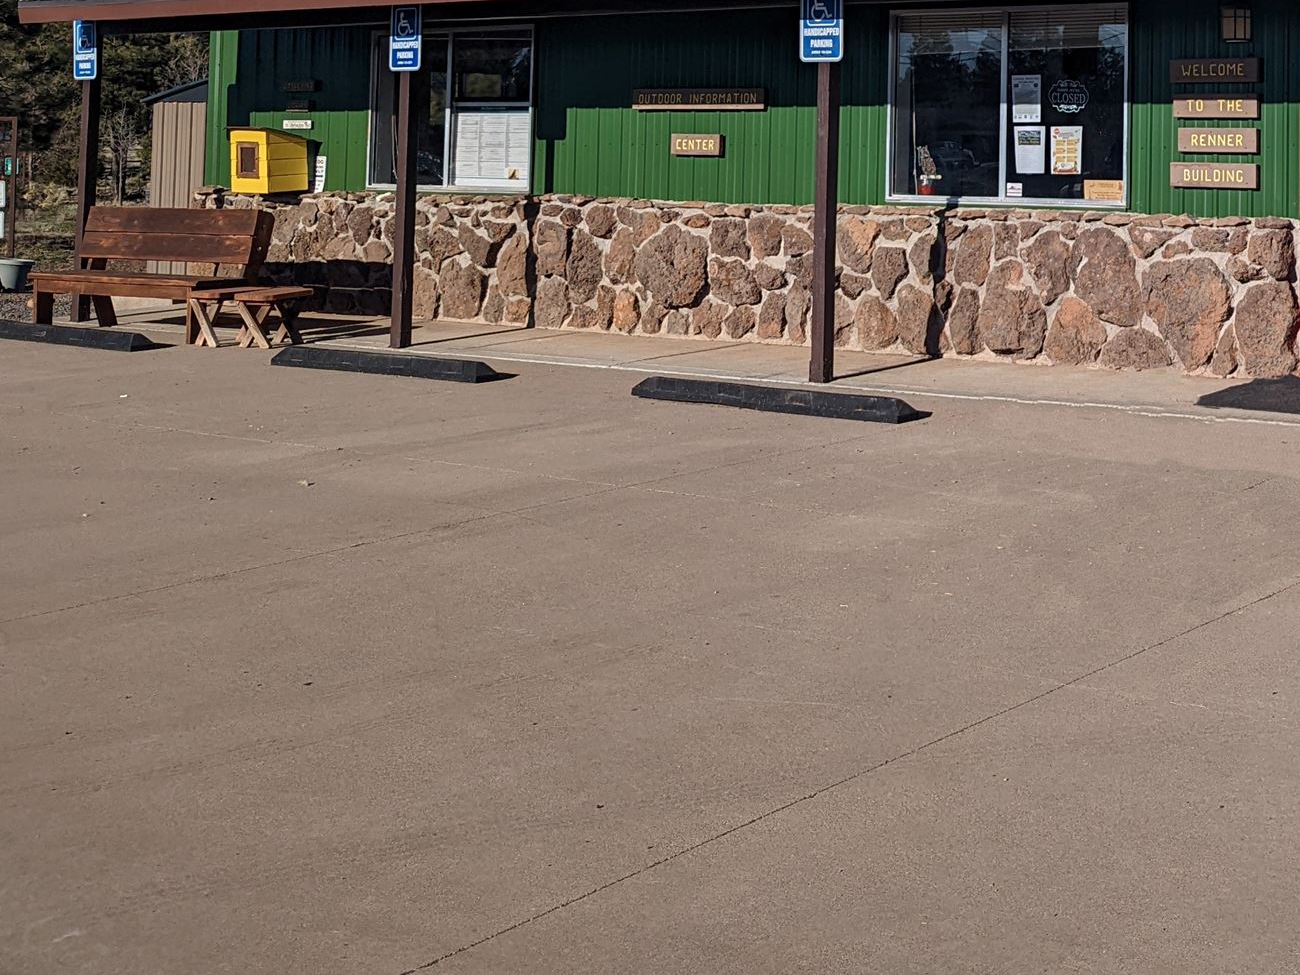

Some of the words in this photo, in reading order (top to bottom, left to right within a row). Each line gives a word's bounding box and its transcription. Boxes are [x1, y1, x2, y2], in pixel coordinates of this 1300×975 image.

[803, 27, 840, 36] HANDICAPPED
[810, 38, 833, 48] PARKING
[1181, 63, 1245, 77] WELCOME
[638, 93, 683, 105] OUTDOOR
[689, 92, 757, 104] INFORMATION
[1051, 92, 1086, 104] CLOSED
[1186, 99, 1204, 112] TO
[1217, 99, 1243, 112] THE
[675, 138, 715, 151] CENTER
[1190, 134, 1244, 147] RENNER
[1183, 168, 1244, 183] BUILDING
